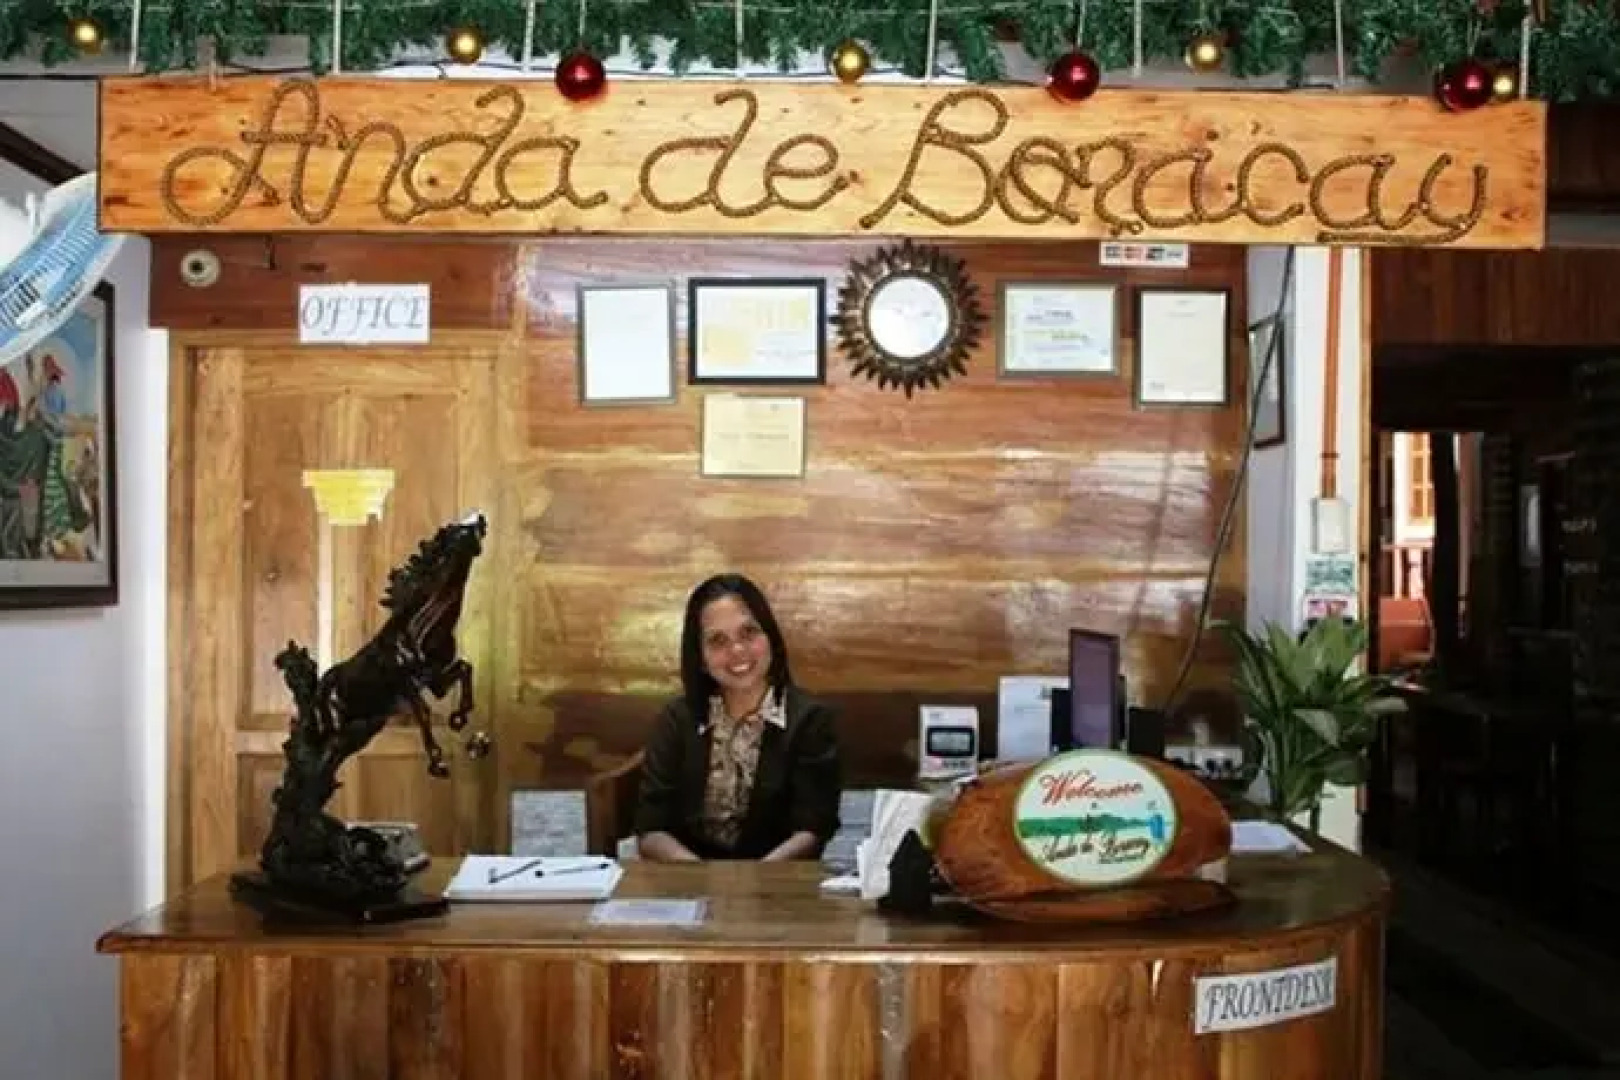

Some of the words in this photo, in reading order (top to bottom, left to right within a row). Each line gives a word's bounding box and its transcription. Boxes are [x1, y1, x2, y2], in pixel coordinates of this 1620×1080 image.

[161, 78, 609, 225] Anda
[638, 87, 859, 219] de
[859, 88, 1490, 246] Boracay
[302, 294, 427, 338] OFFICE
